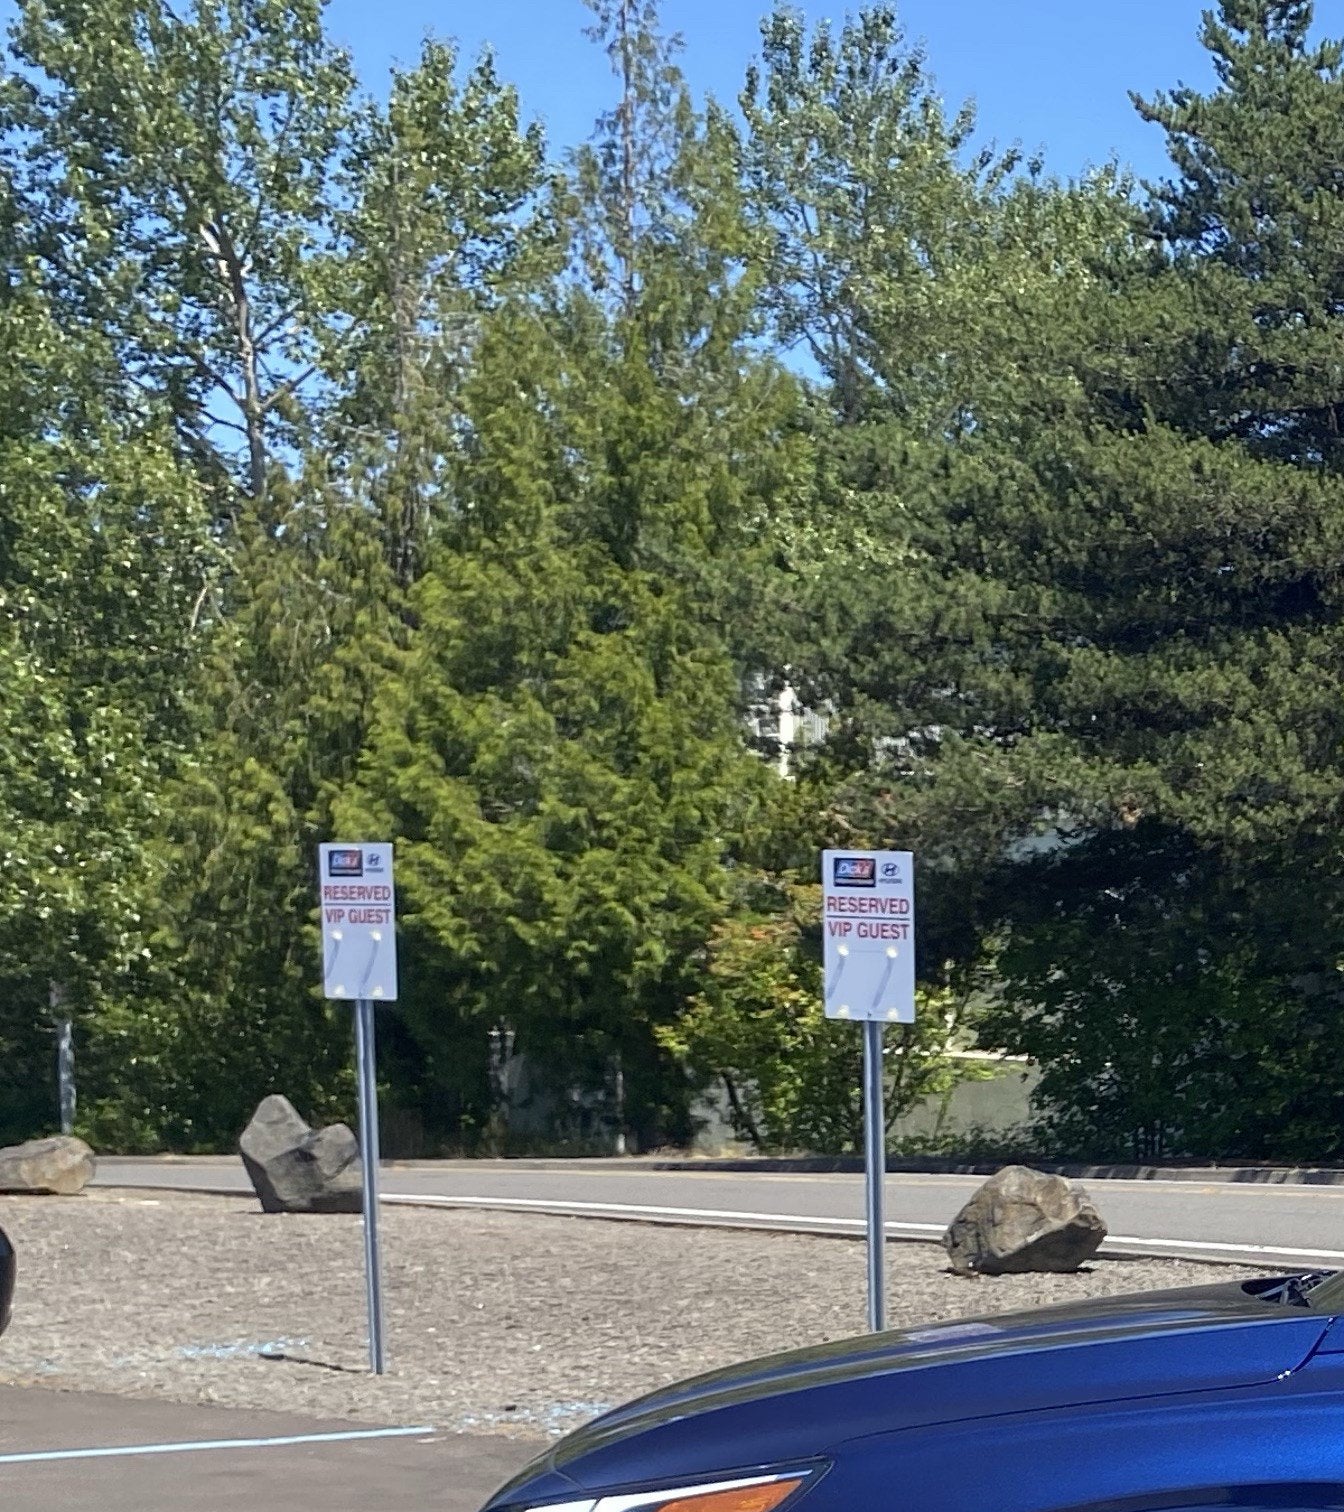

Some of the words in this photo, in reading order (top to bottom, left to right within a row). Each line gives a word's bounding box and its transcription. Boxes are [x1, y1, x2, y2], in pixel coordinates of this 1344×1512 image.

[324, 885, 391, 901] RESERVED
[827, 896, 909, 914] RESERVED
[325, 908, 345, 924] VIP
[348, 908, 391, 924] GUEST
[828, 921, 852, 938] VIP
[857, 922, 910, 940] GUEST
